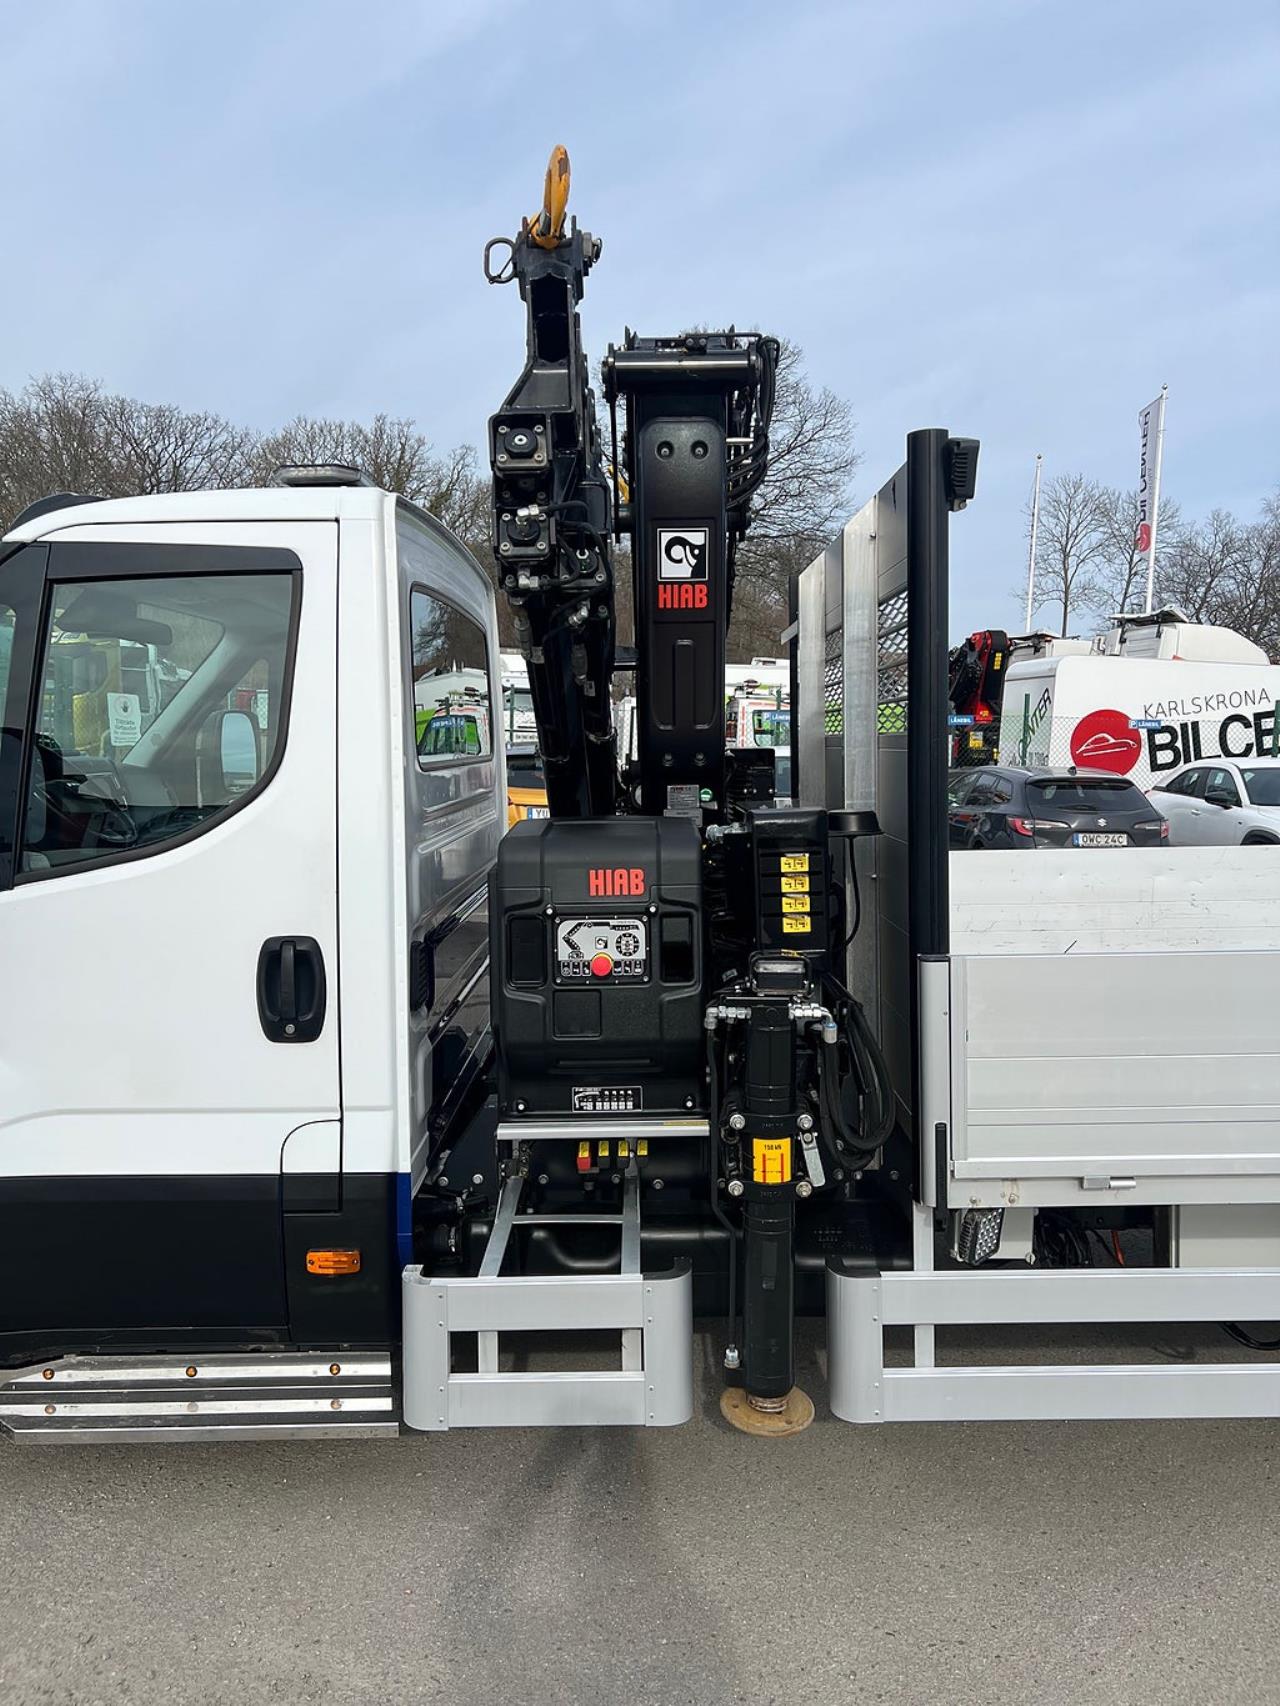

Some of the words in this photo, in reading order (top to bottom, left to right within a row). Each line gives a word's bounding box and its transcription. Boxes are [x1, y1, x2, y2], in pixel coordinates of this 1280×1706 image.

[658, 584, 708, 608] HIAB
[1144, 688, 1271, 720] KARLSKRONA
[589, 869, 645, 896] HIAB
